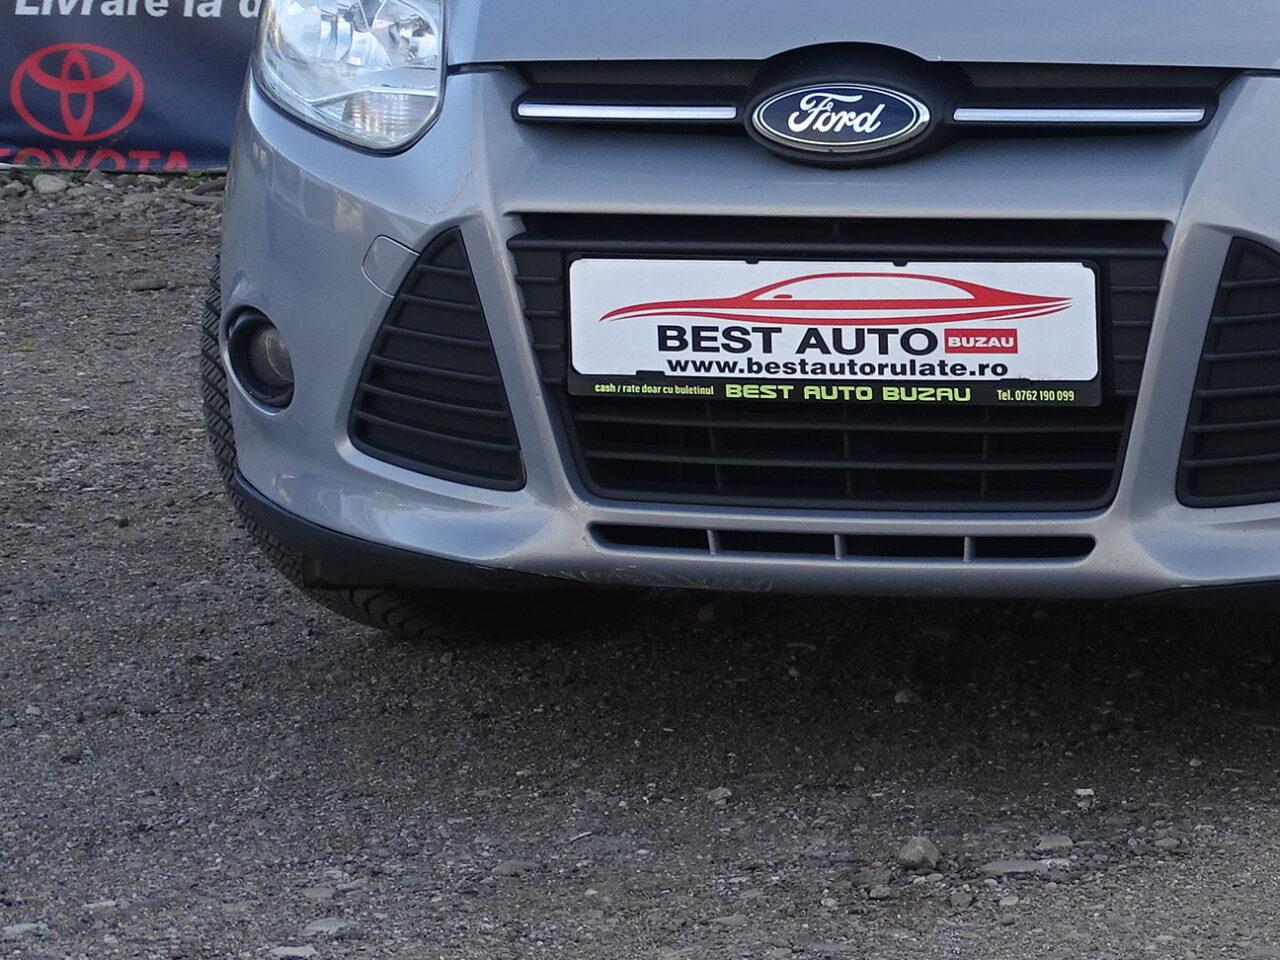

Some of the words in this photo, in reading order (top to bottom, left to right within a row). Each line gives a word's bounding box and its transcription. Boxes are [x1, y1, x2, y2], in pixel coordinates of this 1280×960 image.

[788, 92, 886, 133] Ford
[657, 325, 782, 354] BEST
[795, 327, 938, 355] AUTO
[948, 336, 1015, 348] BUZAU
[666, 357, 1008, 377] www.bestautorulate.ro
[594, 383, 616, 393] cash
[622, 384, 640, 394] rate
[641, 384, 661, 394] doar
[662, 386, 673, 395] cu
[674, 385, 714, 396] buletinul
[725, 383, 794, 399] BEST
[804, 385, 873, 400] AUTO
[882, 386, 971, 401] BUZAU
[997, 389, 1014, 401] Tel.
[1015, 390, 1037, 401] 0762
[1039, 390, 1055, 401] 190
[1056, 390, 1075, 402] 099
